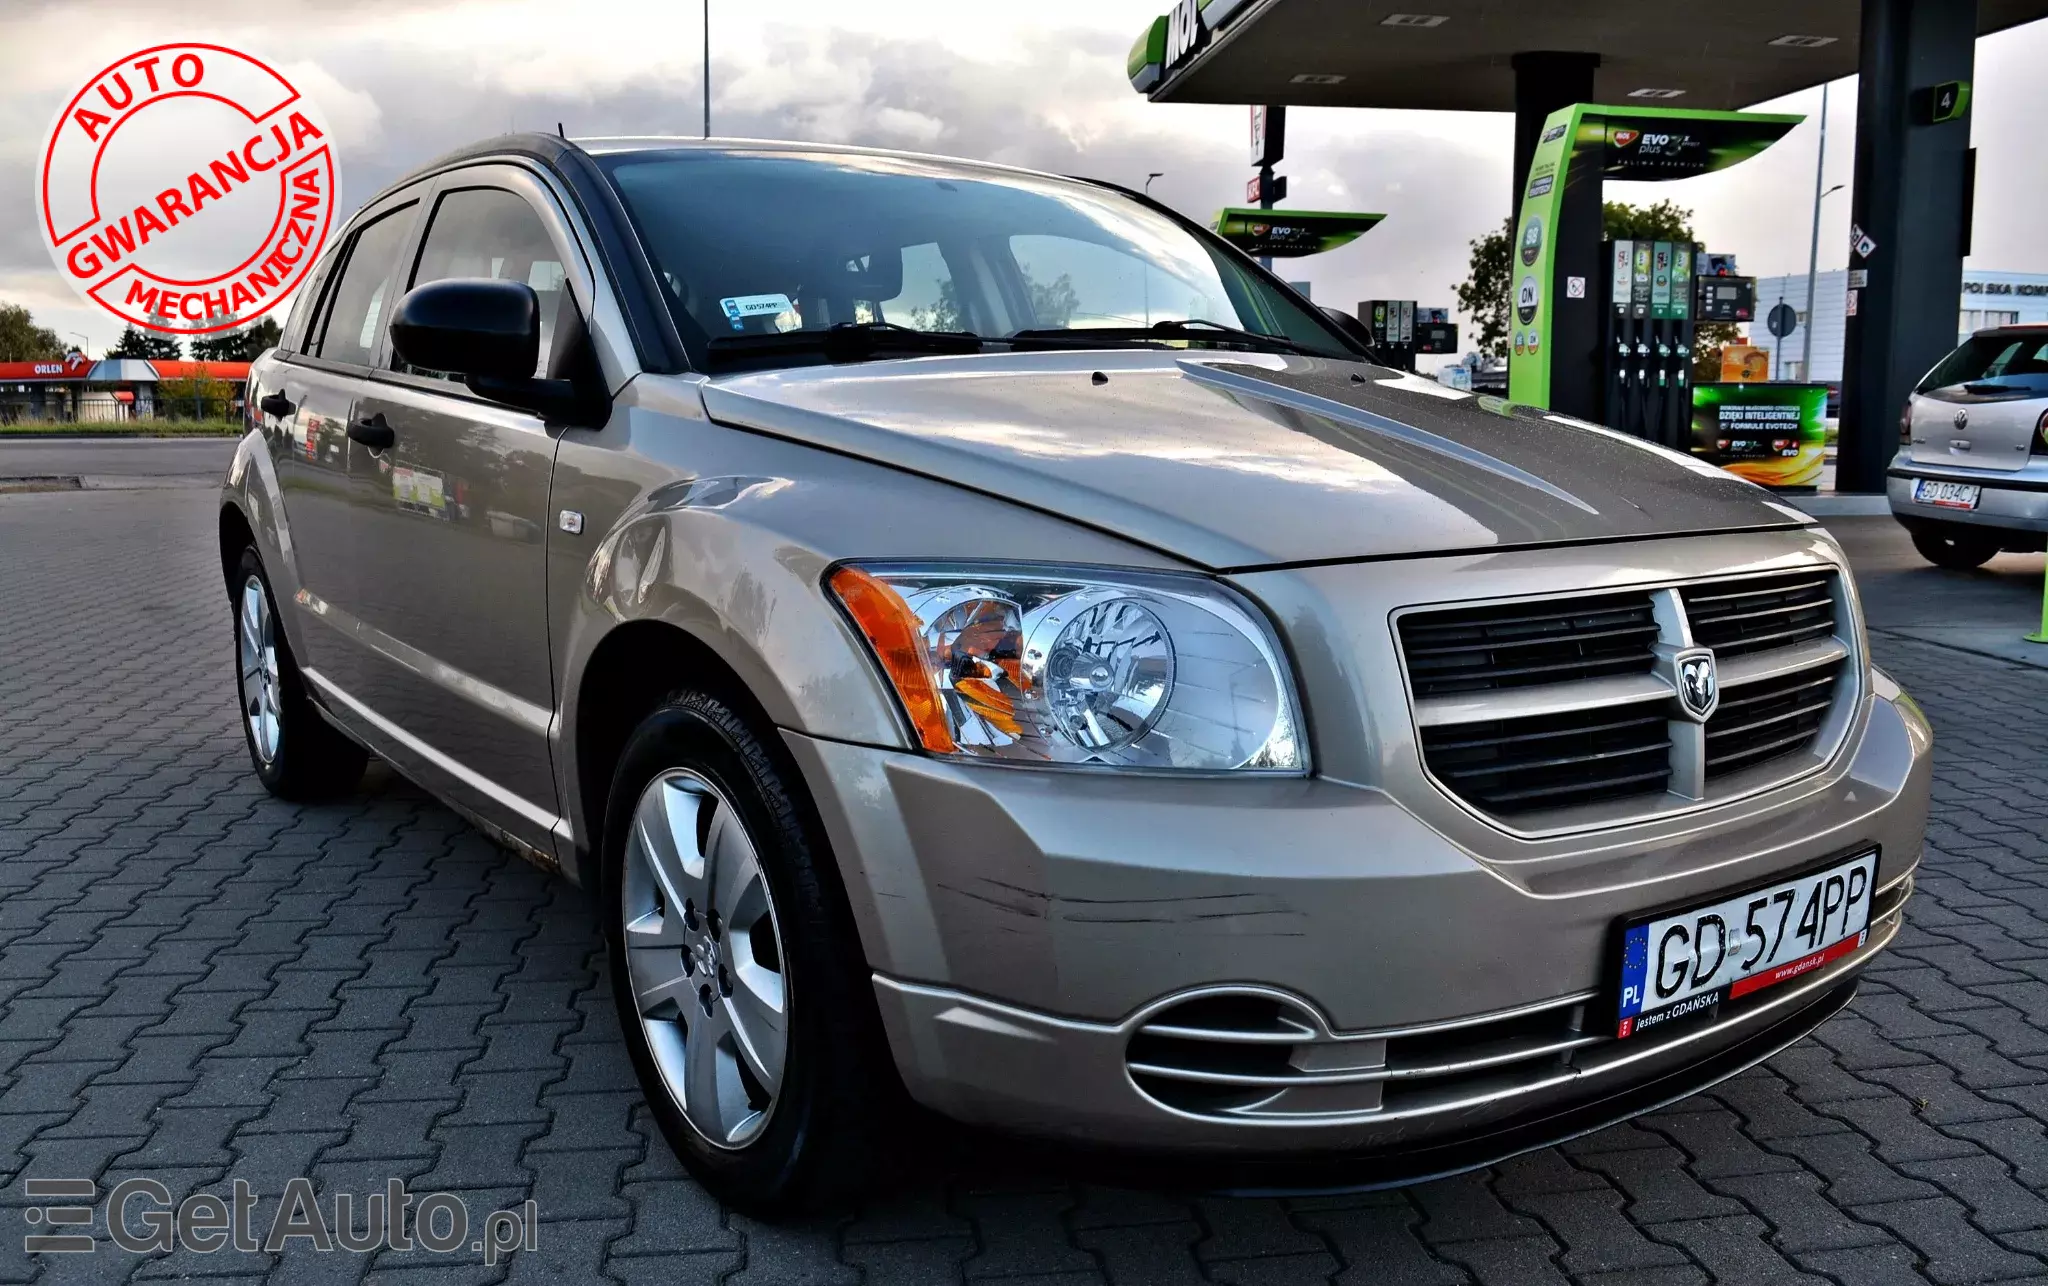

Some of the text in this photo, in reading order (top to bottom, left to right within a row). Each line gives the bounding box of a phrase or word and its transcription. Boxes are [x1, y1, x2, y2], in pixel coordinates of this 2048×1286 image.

[1165, 0, 1198, 70] MOL
[1941, 92, 1951, 108] 4
[1641, 133, 1670, 145] EVO
[1639, 144, 1661, 154] plus
[1271, 226, 1291, 235] EVO
[1521, 287, 1533, 303] ON
[34, 364, 63, 374] ORLEN
[1781, 449, 1799, 457] EVO
[1655, 866, 1867, 999] GD 574PP
[1775, 953, 1825, 979] www.gdansk.pl
[1622, 985, 1640, 1008] PL
[1635, 1013, 1664, 1031] jestem
[1666, 1010, 1673, 1020] z
[1672, 991, 1719, 1018] GDAŃSKA
